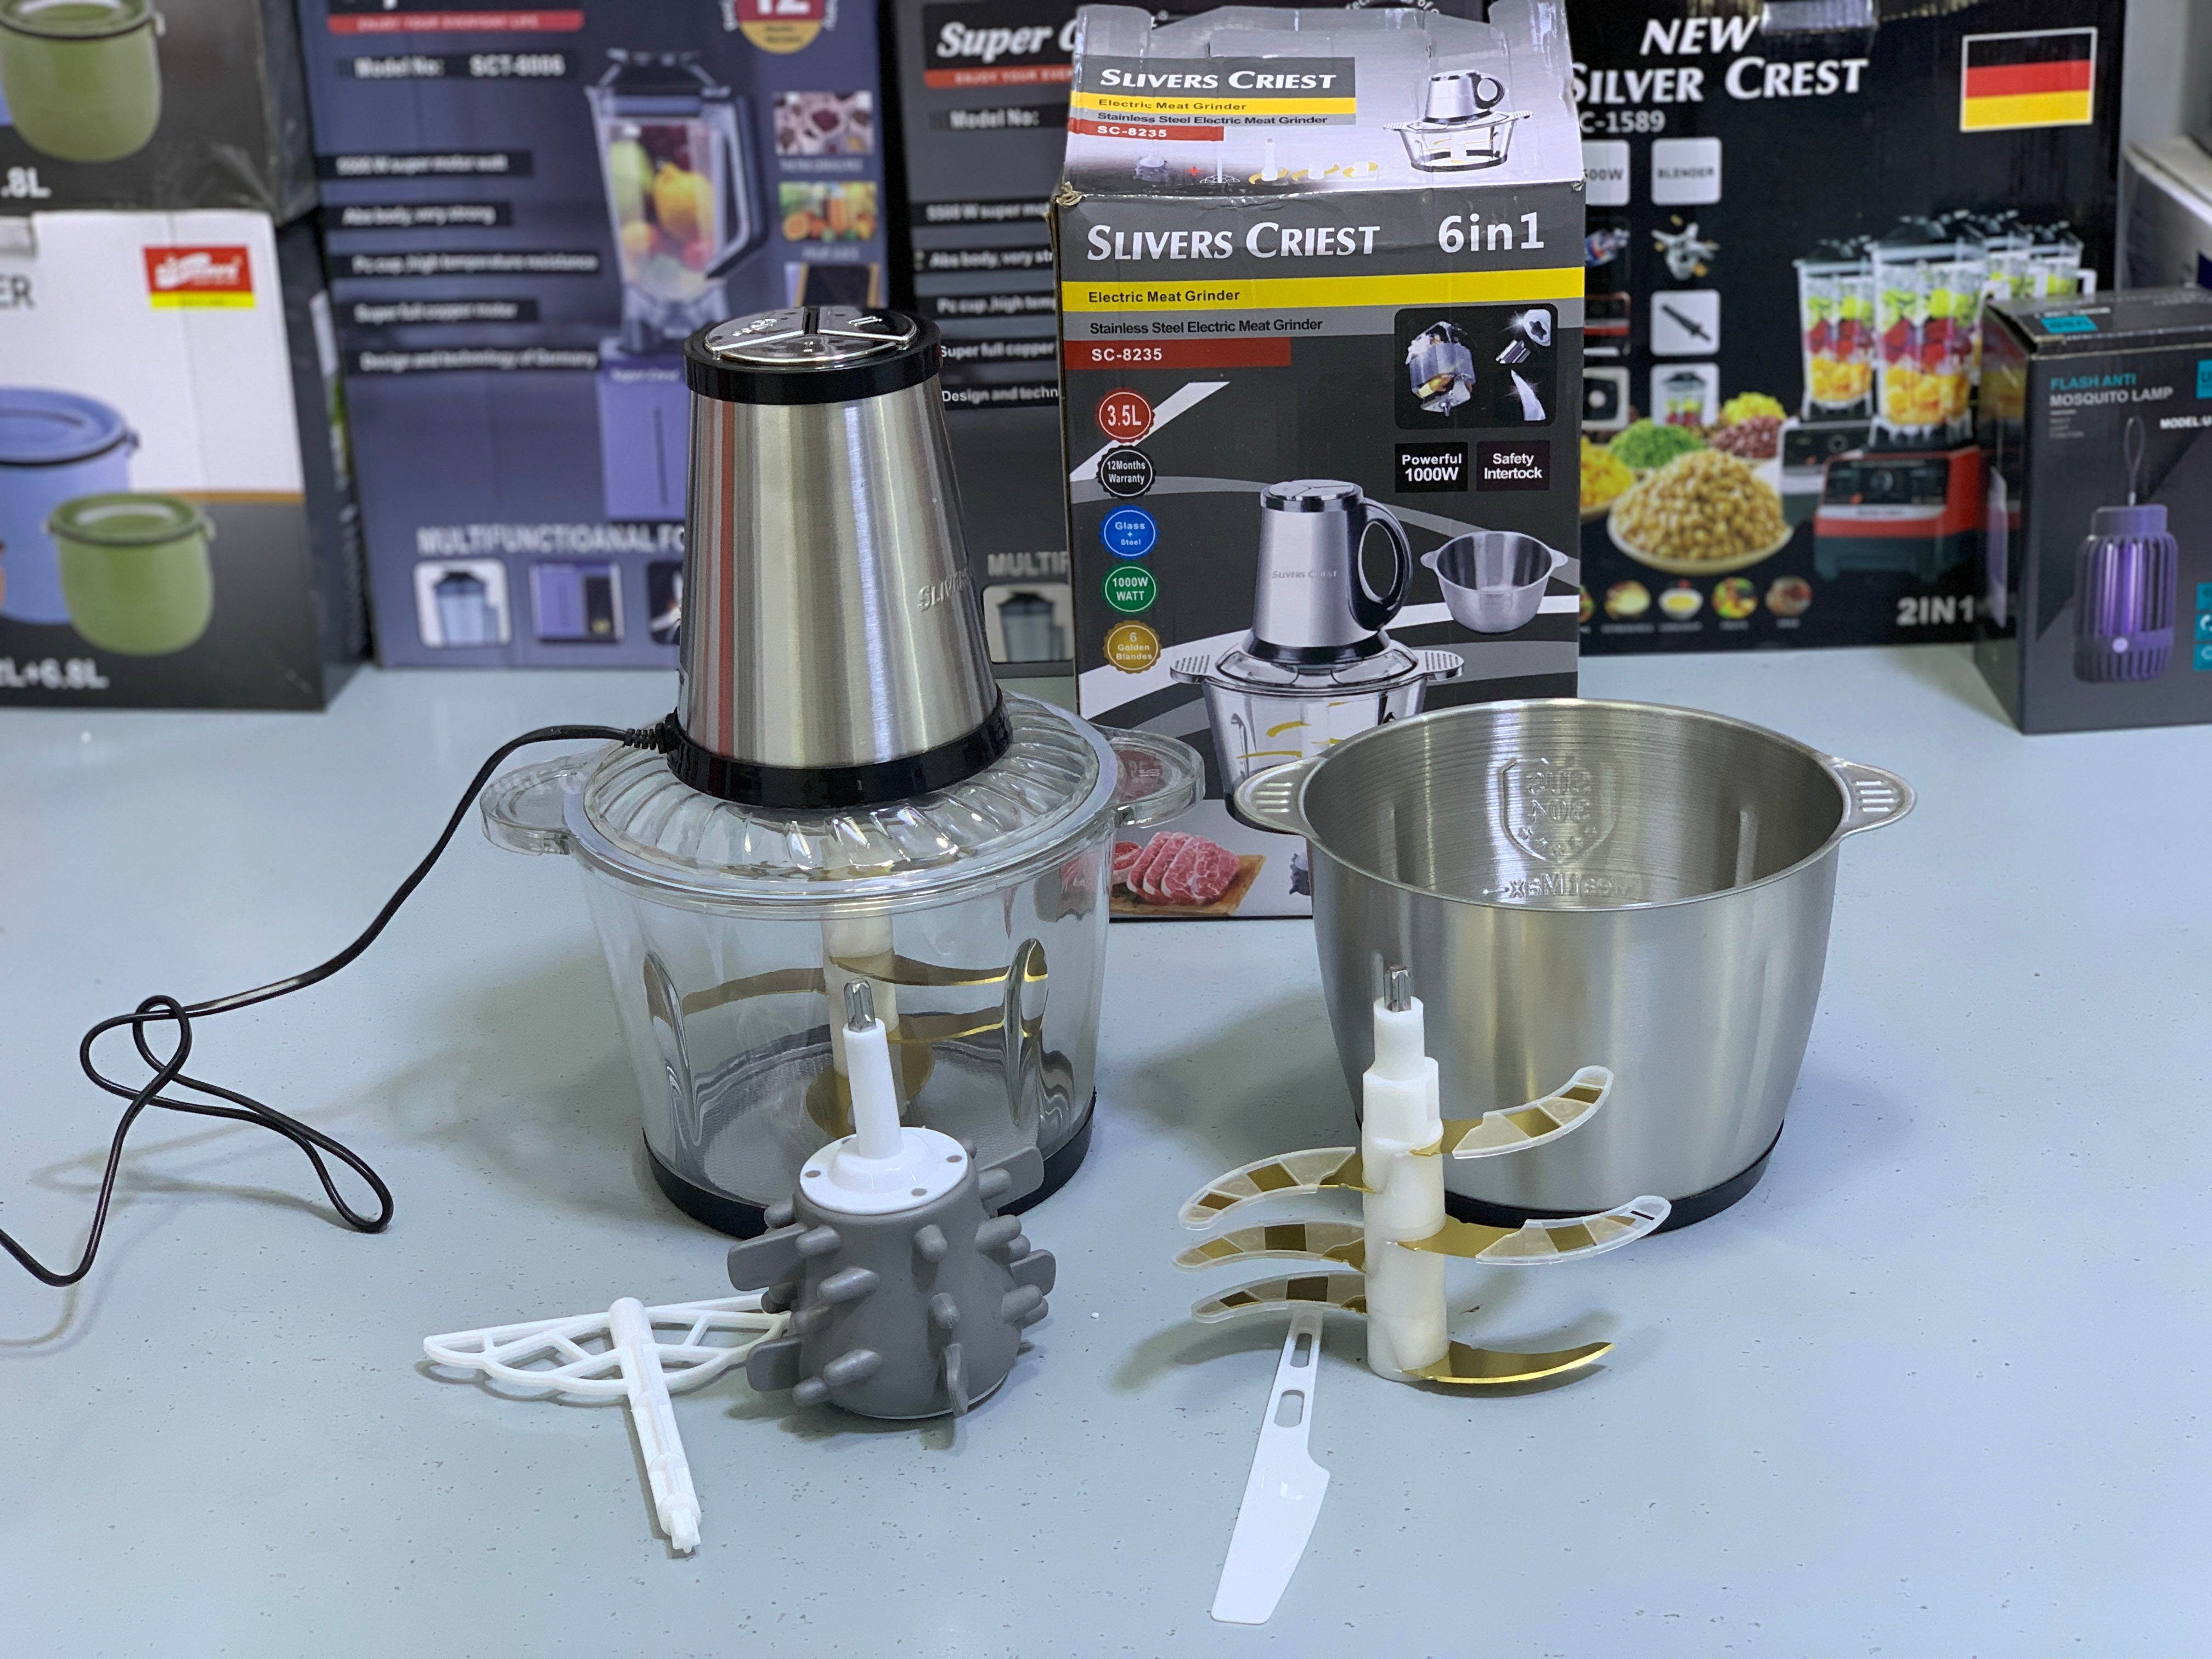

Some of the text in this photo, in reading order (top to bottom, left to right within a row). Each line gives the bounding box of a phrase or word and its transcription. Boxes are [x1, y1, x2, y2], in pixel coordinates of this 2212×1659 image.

[936, 21, 1053, 64] Super
[1640, 15, 1759, 55] NEW
[953, 71, 997, 86] ENJOY
[1002, 70, 1037, 83] YOUR
[1100, 69, 1336, 89] SLIVERS CRIEST
[1572, 57, 1869, 104] SILVER CREST
[1098, 98, 1247, 111] Electric Meat Grinder
[950, 109, 1040, 129] Model No:
[1097, 112, 1328, 125] Stainless Steel Electric Meat Grinder
[1097, 125, 1167, 138] SC-8235
[1657, 167, 1714, 179] BLENDER
[981, 204, 1020, 221] super
[1087, 212, 1544, 261] SLIVERS CRIEST 6in1
[1002, 252, 1032, 267] very
[1088, 290, 1240, 303] Electric Meat Grinder
[1090, 318, 1323, 335] Stainless Steel Electric Meat Grinder
[941, 345, 979, 360] Super
[981, 341, 1005, 357] full
[1091, 347, 1163, 362] SC-8235
[2050, 373, 2137, 391] FLASH ANTI
[942, 390, 989, 405] Design
[991, 388, 1020, 401] and
[2050, 386, 2174, 407] MOSQUITO LAMP
[1107, 404, 1142, 427] 3.5L
[1107, 460, 1146, 471] 12Months
[1402, 453, 1462, 465] Powerful
[1492, 453, 1534, 467] Safety
[1108, 473, 1146, 485] Warranty
[1404, 466, 1459, 482] 1000W
[1484, 467, 1543, 480] Intertock
[1115, 521, 1146, 531] Glass
[1112, 577, 1148, 588] 1000W
[1272, 571, 1305, 579] SLIVERS
[1116, 590, 1145, 601] WATT
[1896, 595, 1974, 627] 2IN1
[1129, 632, 1137, 642] 6
[1116, 652, 1153, 661] Blandes
